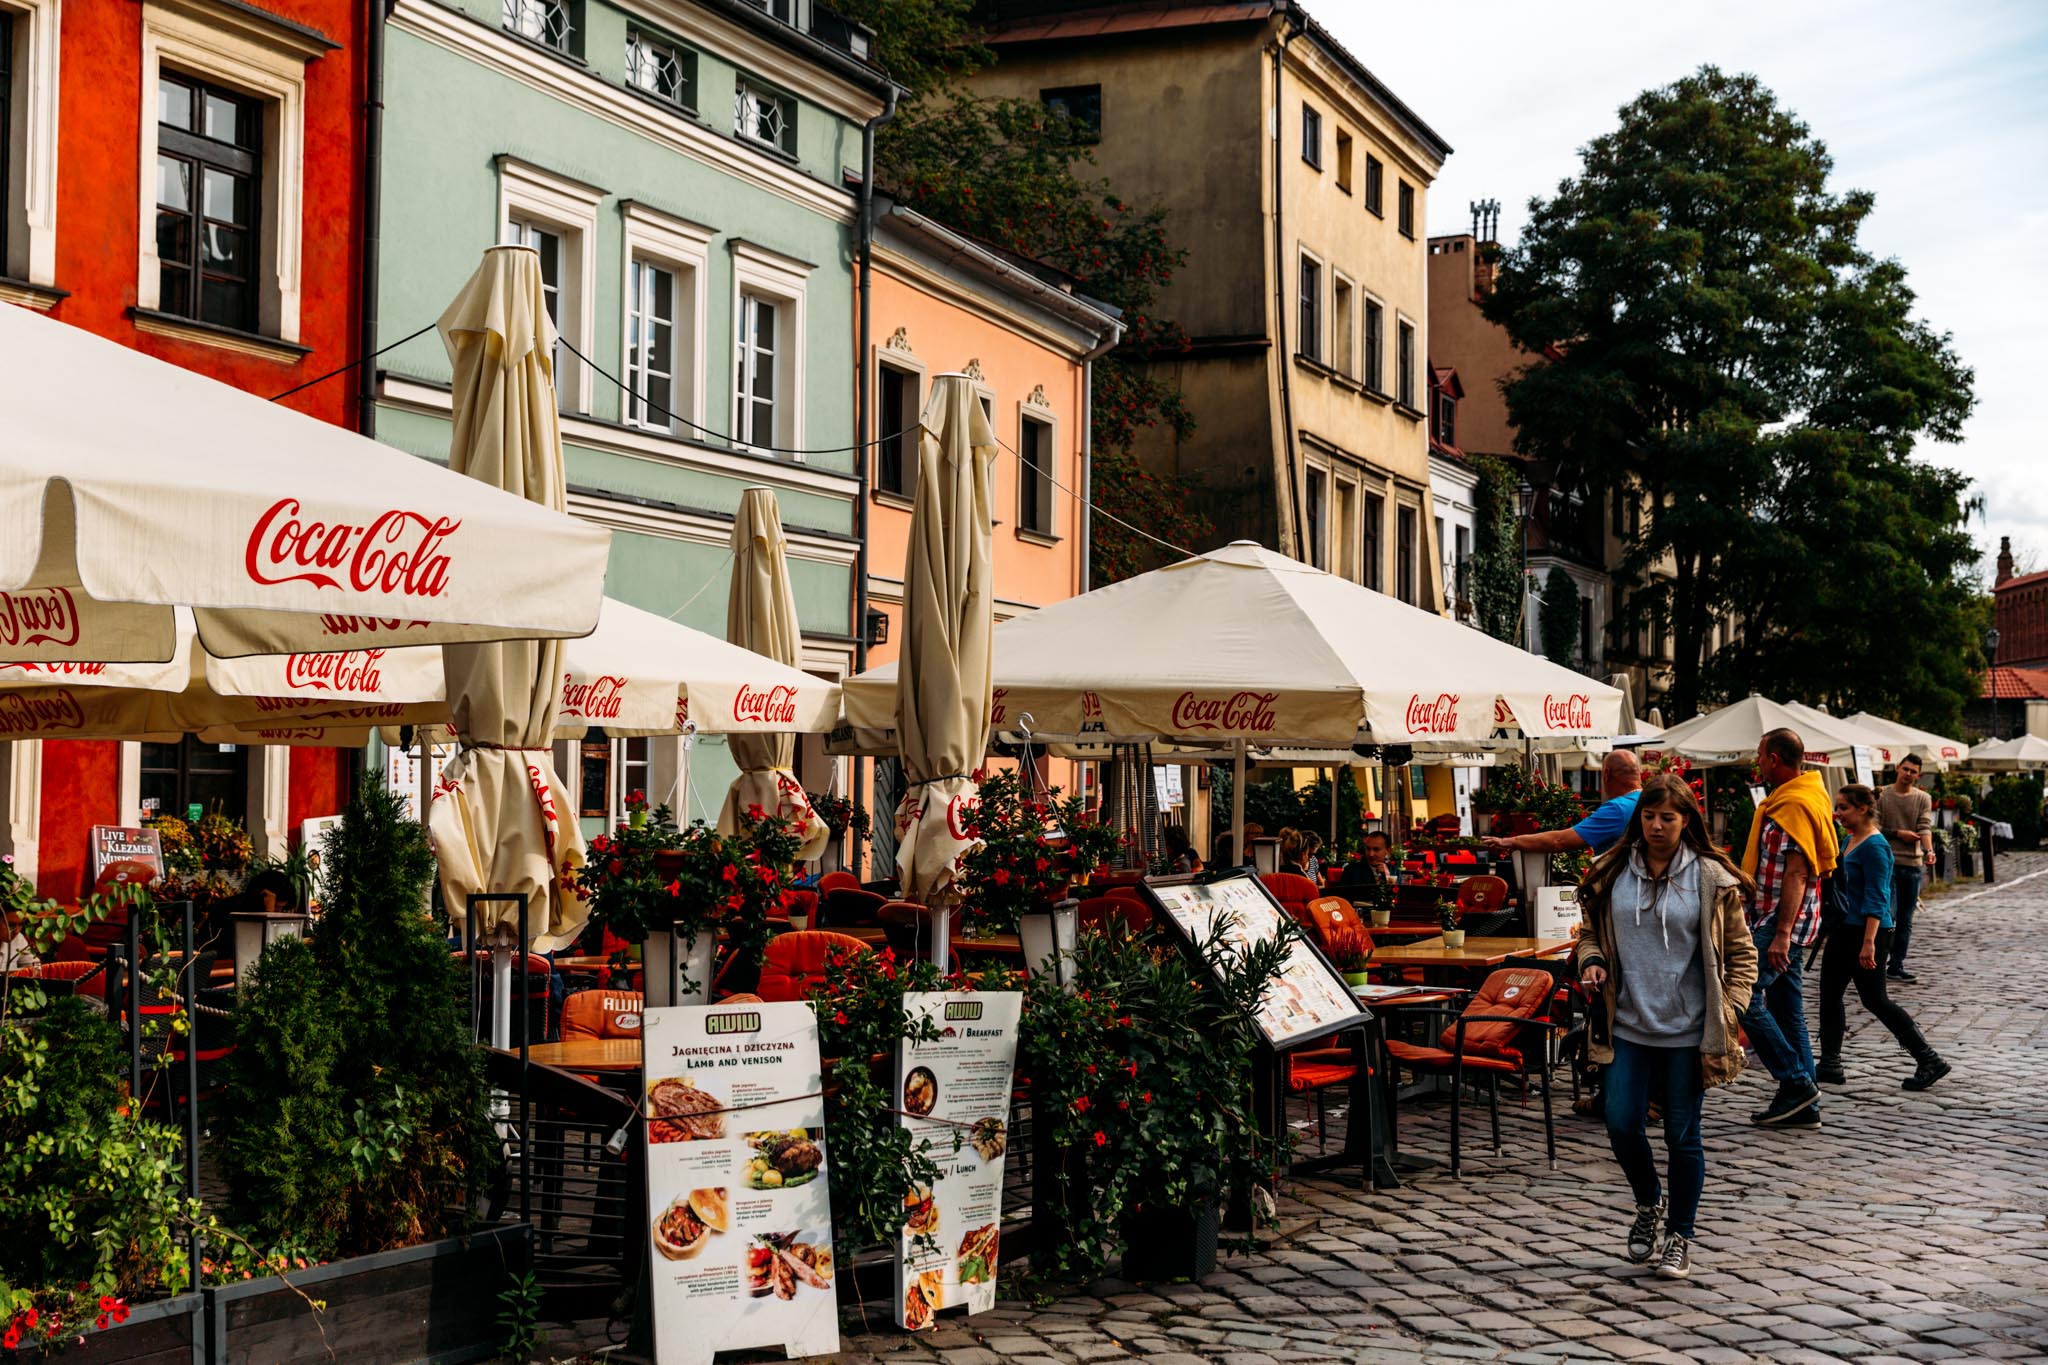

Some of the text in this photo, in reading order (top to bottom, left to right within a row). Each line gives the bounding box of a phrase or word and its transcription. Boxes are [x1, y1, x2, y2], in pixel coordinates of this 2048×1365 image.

[245, 497, 462, 597] Coca-Cola
[286, 649, 386, 693] Coca-Cola
[559, 672, 628, 719] oca-Cola
[734, 683, 799, 723] Coca-Cola
[1171, 691, 1280, 732] Coca-Cola
[1406, 693, 1460, 735] Coca-Cola
[1543, 693, 1592, 730] Coca-Cola
[101, 828, 125, 841] LIVE
[107, 840, 154, 854] KLEZMER
[687, 1058, 714, 1069] LAMB
